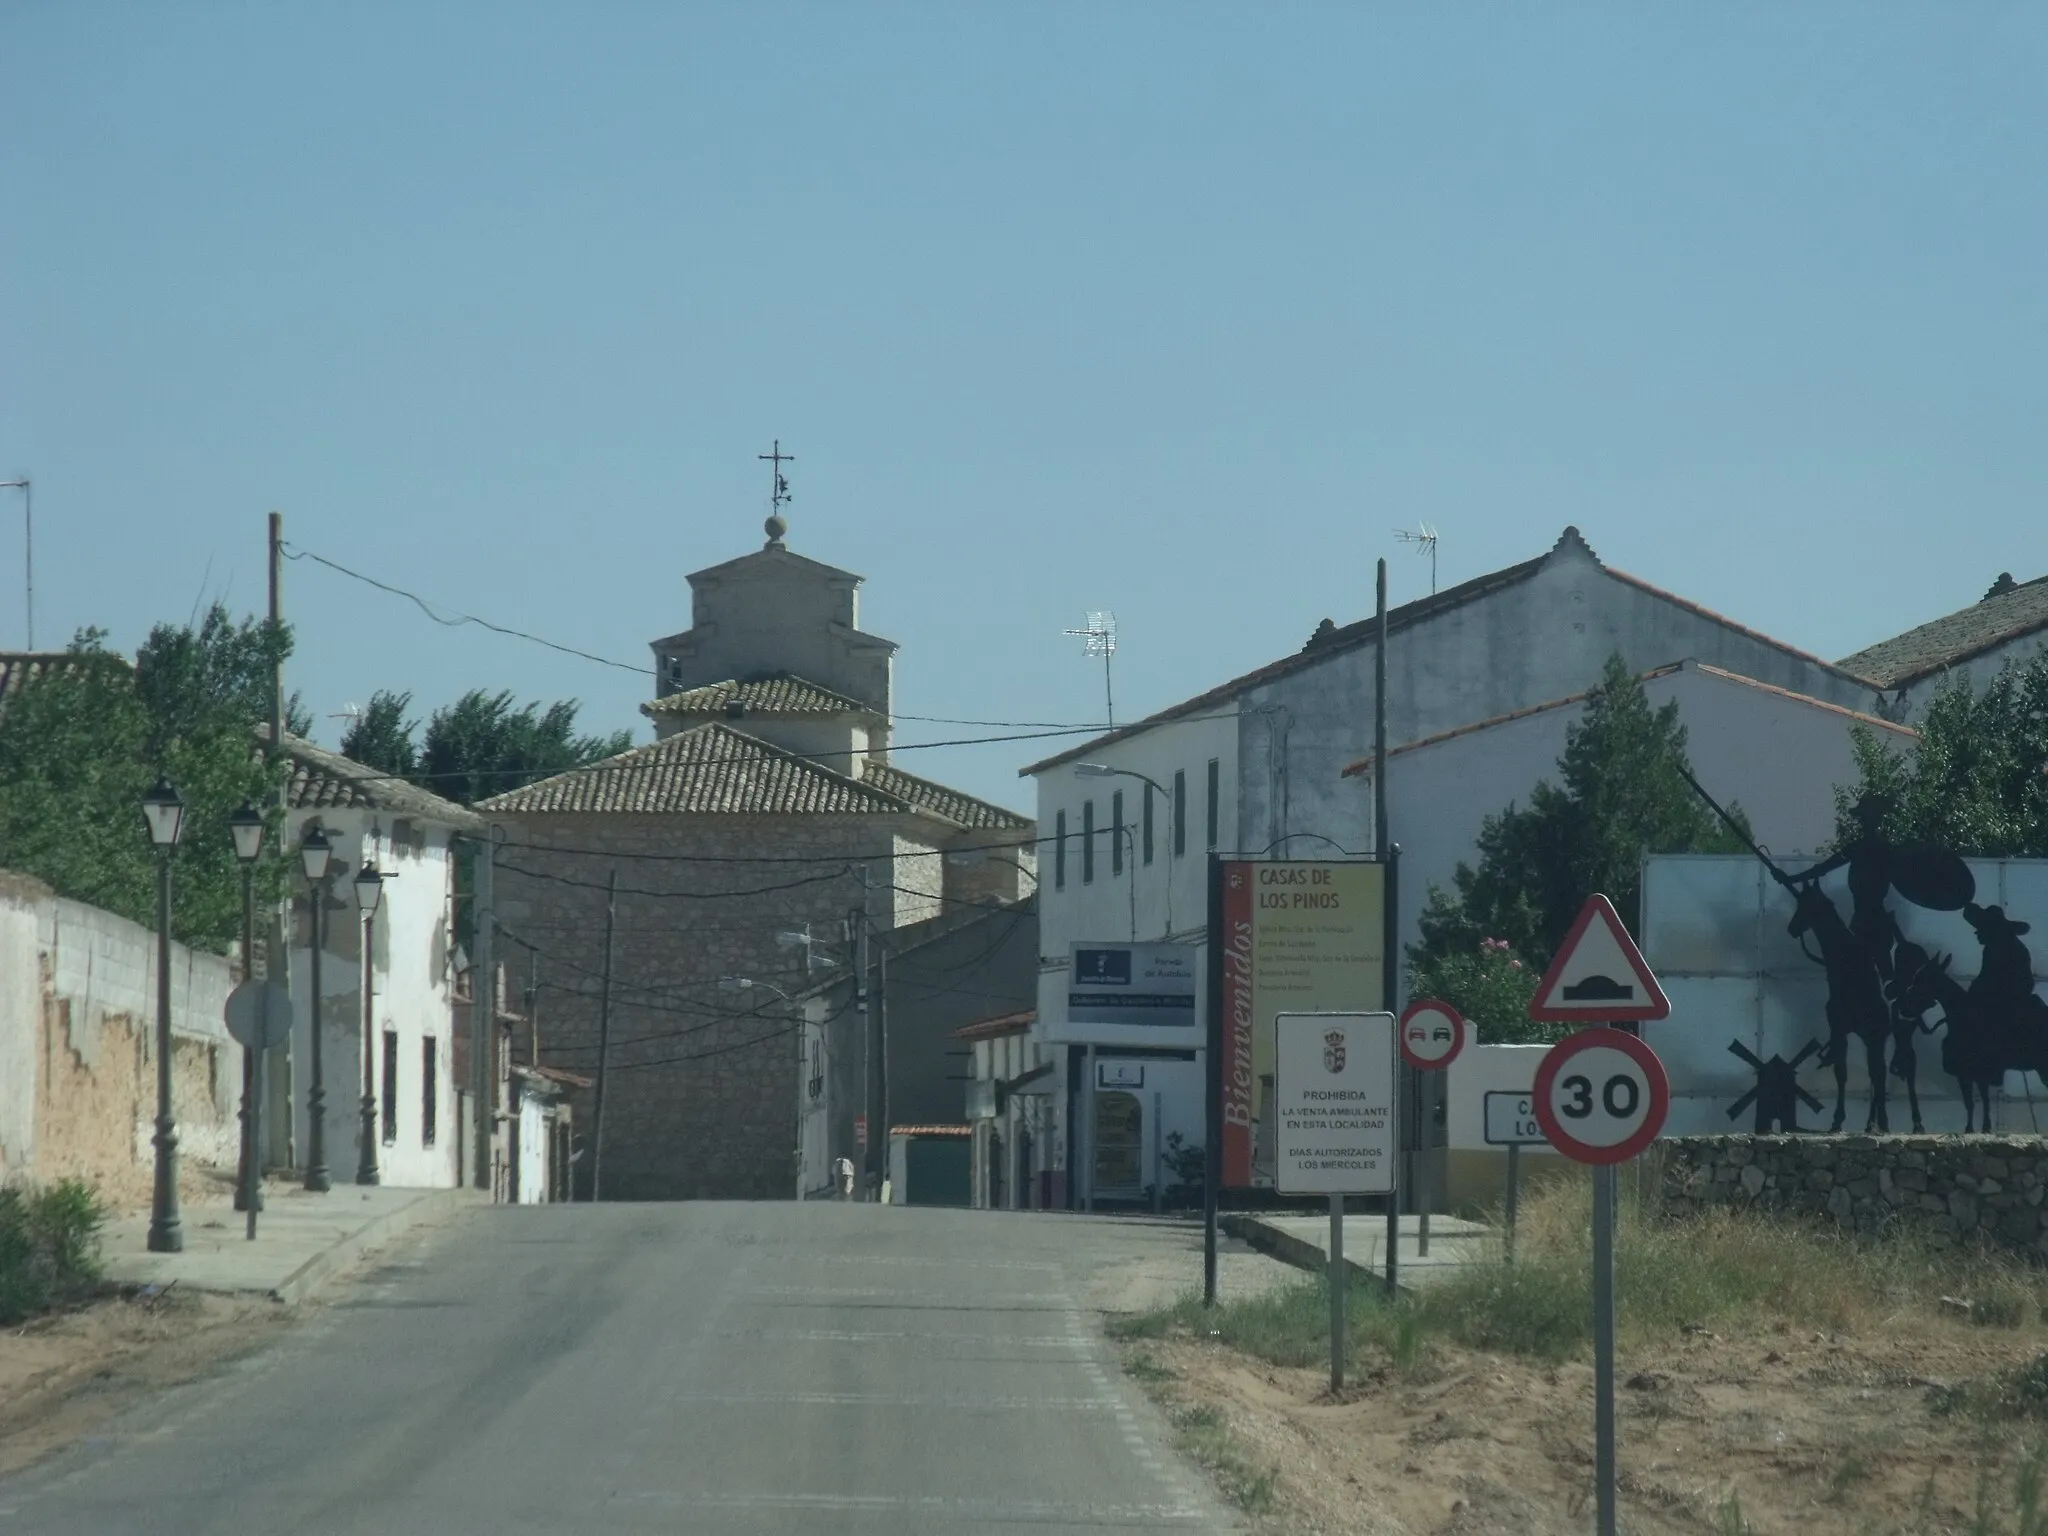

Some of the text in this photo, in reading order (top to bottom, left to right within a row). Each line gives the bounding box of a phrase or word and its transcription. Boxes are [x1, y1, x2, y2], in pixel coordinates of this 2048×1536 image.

[1260, 868, 1332, 885] CASAS DE
[1260, 892, 1340, 909] LOS PINOS
[1224, 921, 1252, 1129] Bienvenidos
[1303, 1090, 1367, 1101] PROHIBIDA
[1561, 1074, 1639, 1119] 30
[1282, 1107, 1389, 1116] LA VENTA AMBULANTE
[1287, 1120, 1385, 1129] EN ESTA LOCALIDAD
[1516, 1121, 1543, 1136] LO
[1314, 1148, 1383, 1157] AUTORIZADOS
[1298, 1160, 1318, 1169] LOS
